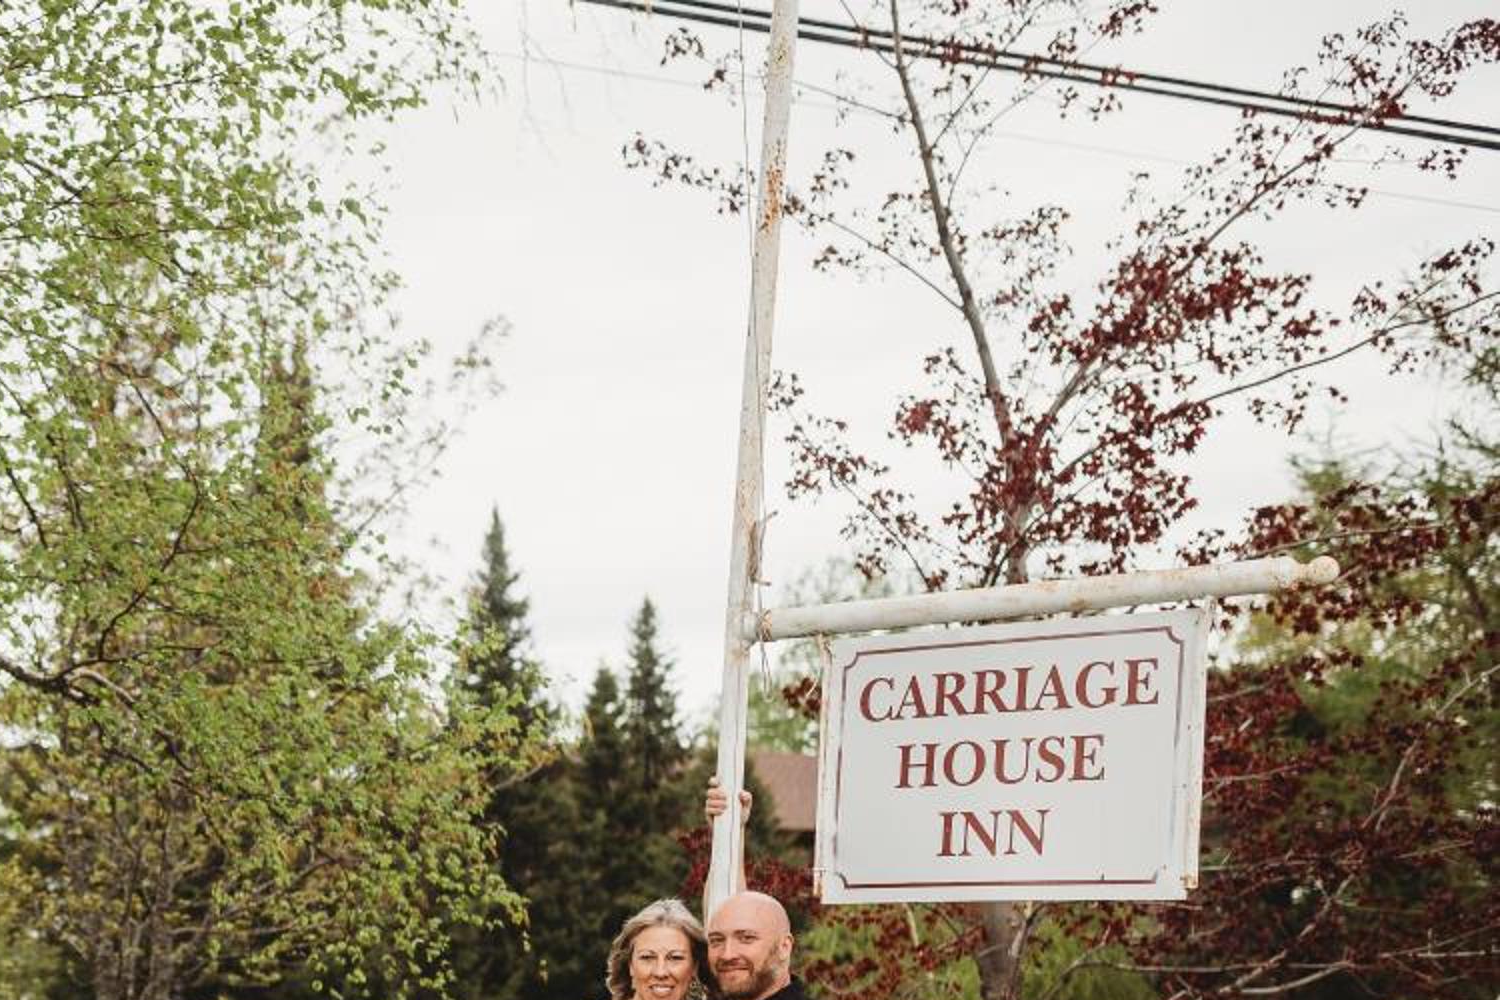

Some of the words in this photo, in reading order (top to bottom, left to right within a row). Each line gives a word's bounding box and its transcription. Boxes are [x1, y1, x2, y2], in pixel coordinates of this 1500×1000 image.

[859, 658, 1159, 722] CARRIAGE
[894, 734, 1105, 789] HOUSE
[936, 809, 1050, 857] INN
